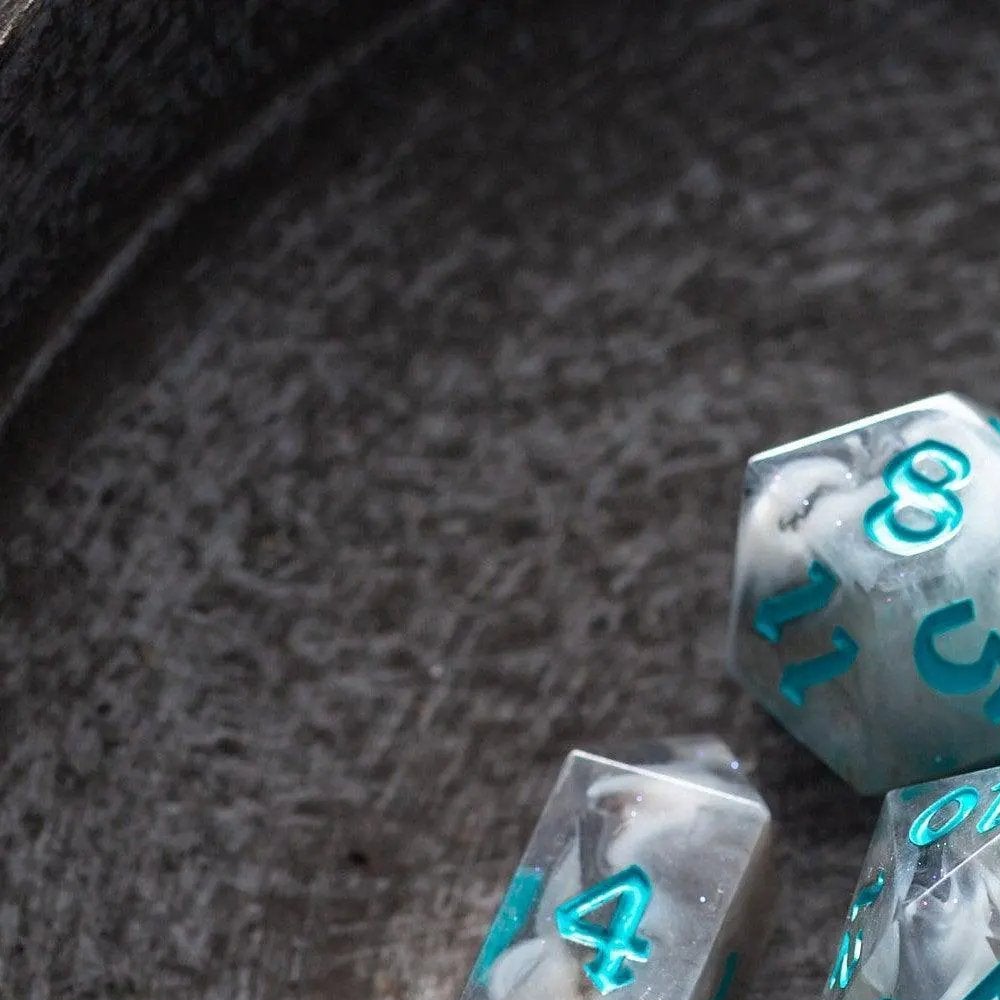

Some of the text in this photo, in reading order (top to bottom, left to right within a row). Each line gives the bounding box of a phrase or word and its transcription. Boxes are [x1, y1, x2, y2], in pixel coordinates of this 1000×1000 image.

[863, 439, 971, 556] 8
[752, 560, 860, 711] 11
[554, 863, 654, 994] 4
